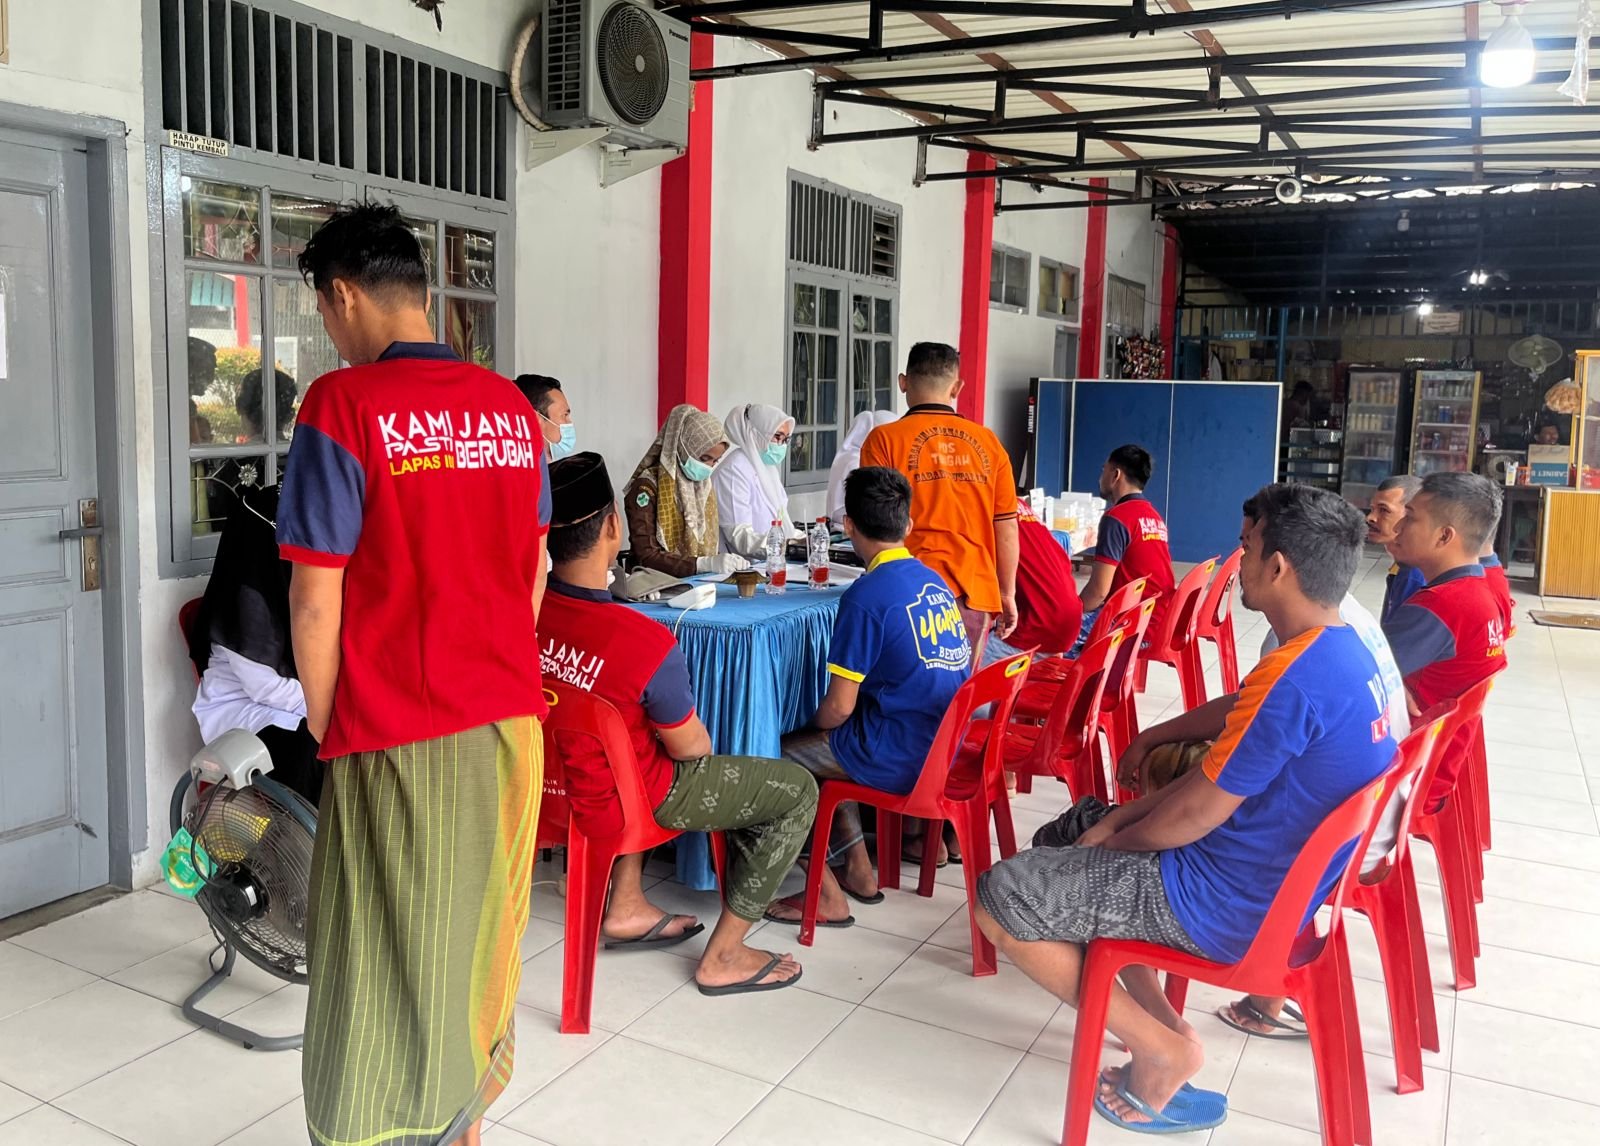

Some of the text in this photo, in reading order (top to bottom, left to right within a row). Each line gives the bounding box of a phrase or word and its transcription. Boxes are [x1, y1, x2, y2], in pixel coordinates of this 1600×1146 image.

[173, 132, 226, 148] HARAP TUTUP
[173, 139, 226, 155] PINTU KEMBALI
[377, 410, 531, 442] KAMI JANJI
[385, 436, 534, 469] PASTI BERUBAH
[390, 454, 442, 476] LAPAS
[542, 638, 604, 679] JANJI
